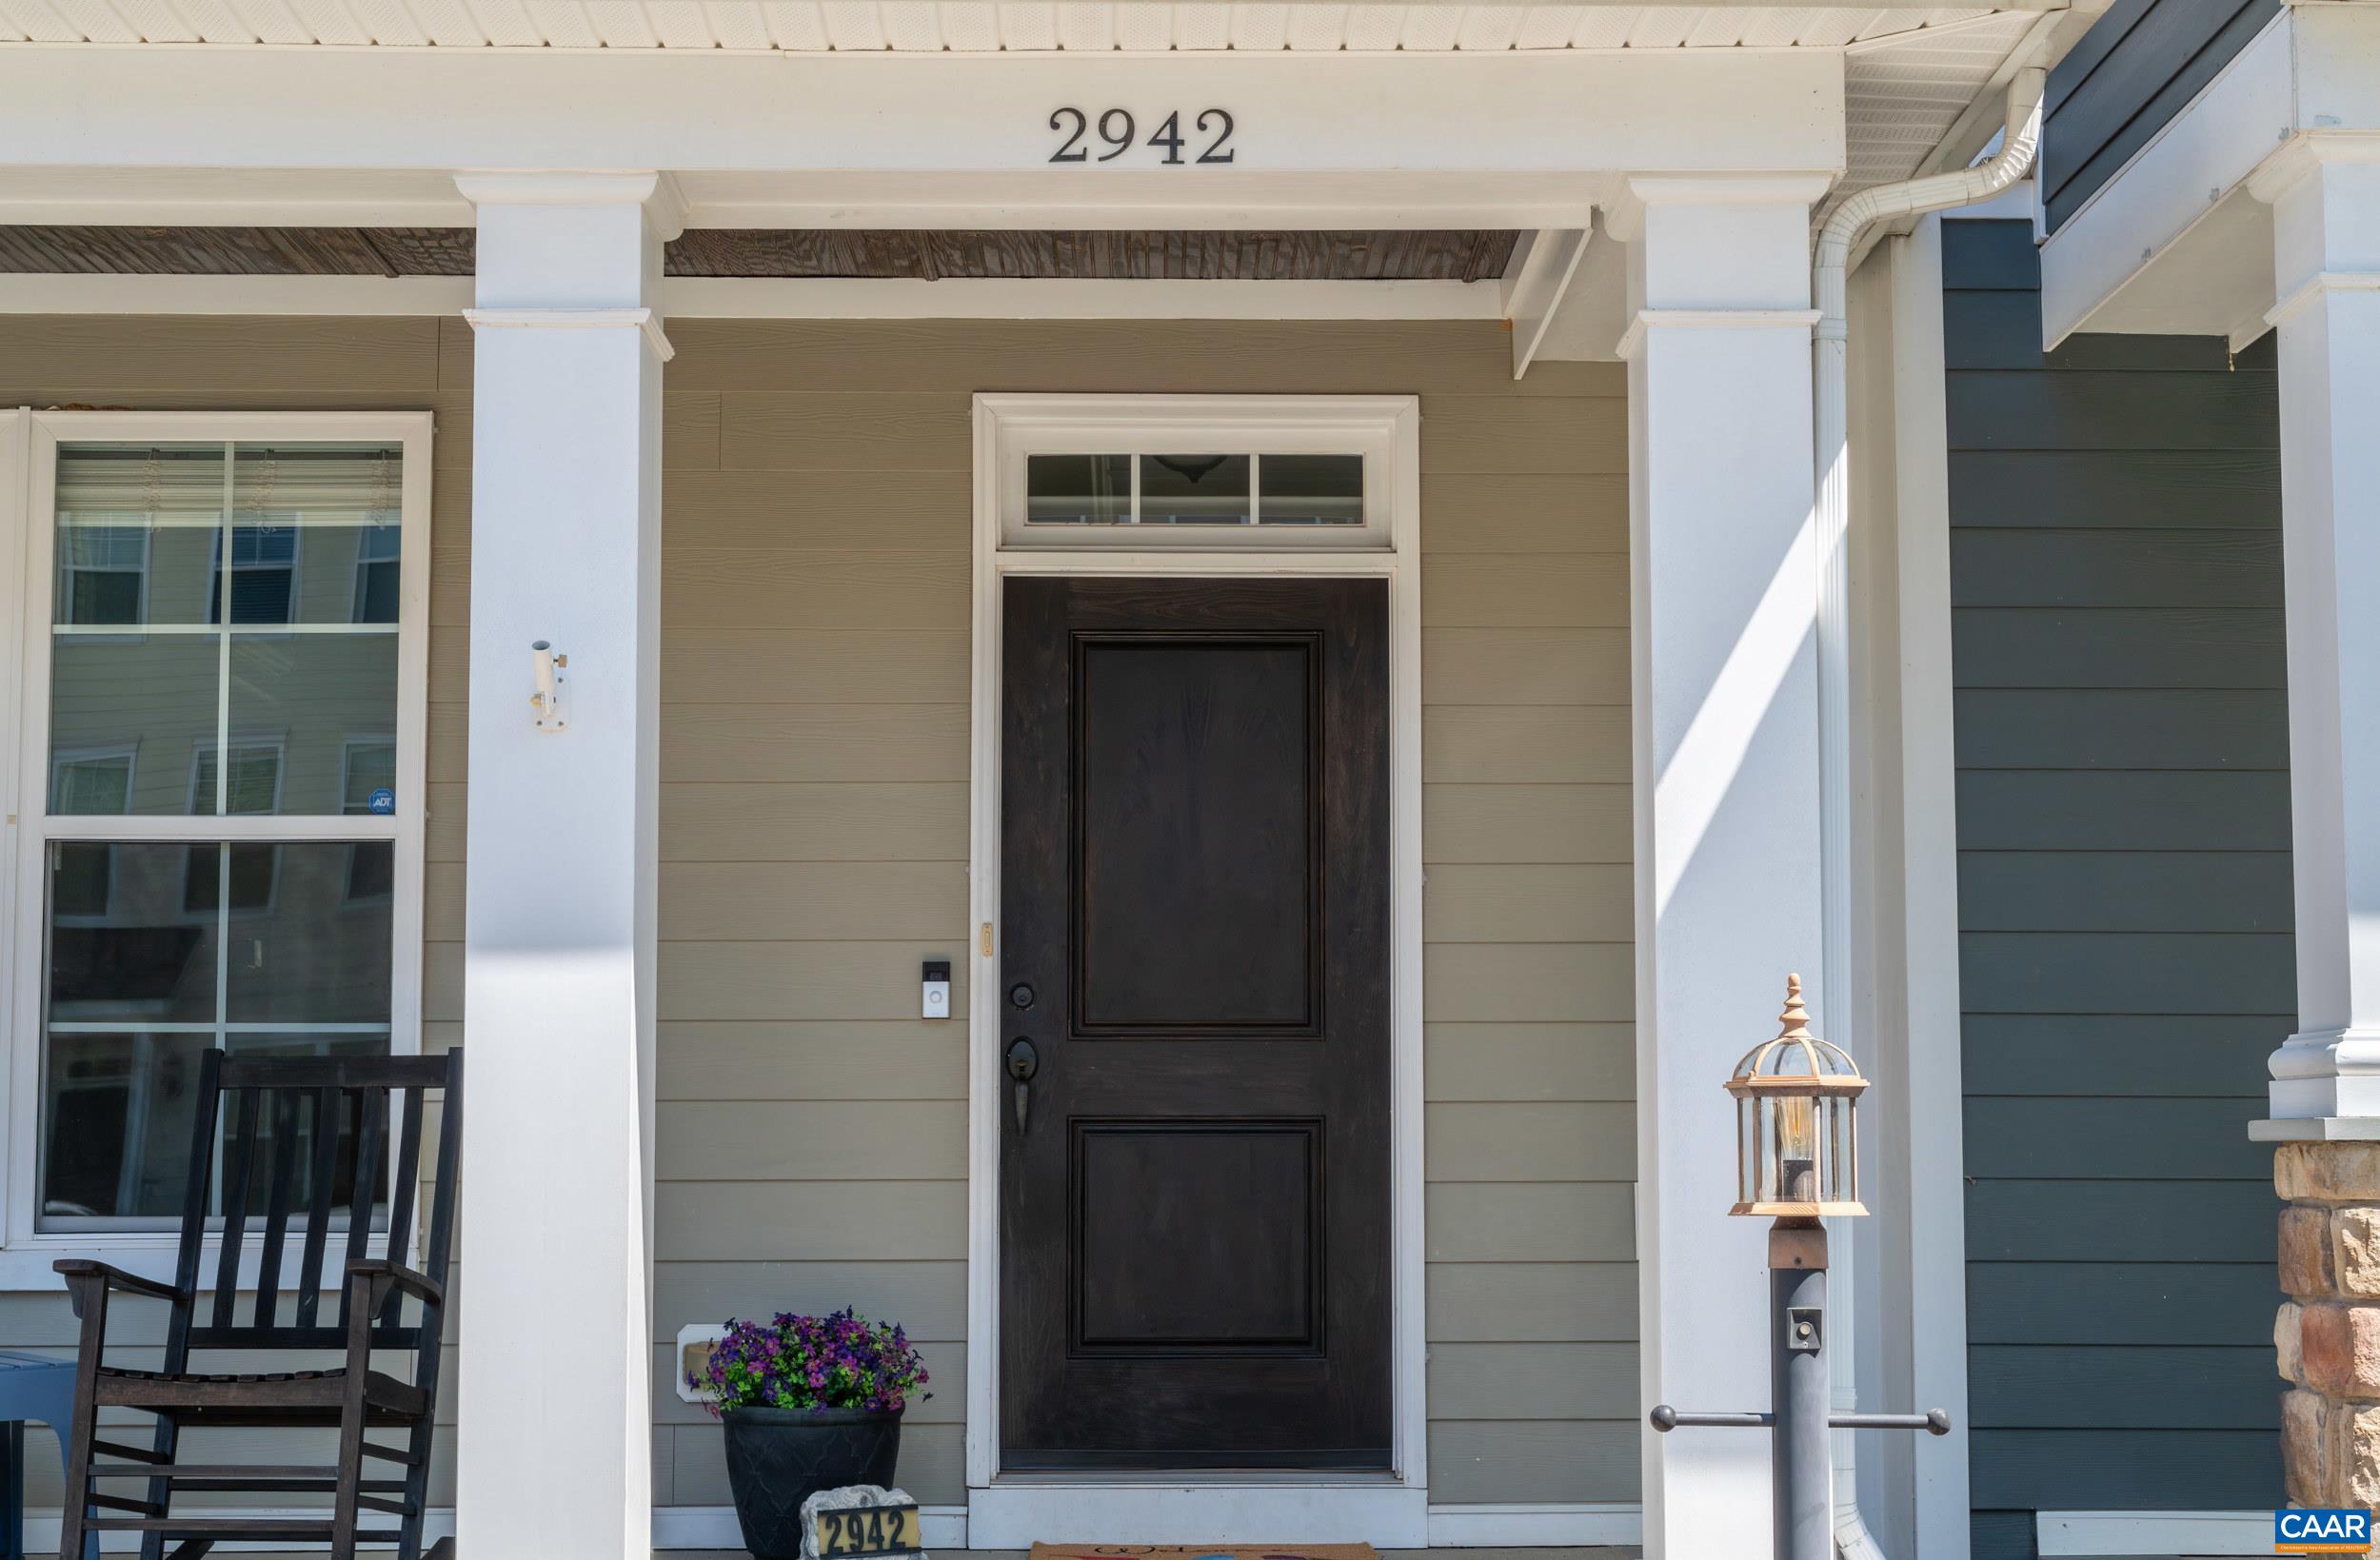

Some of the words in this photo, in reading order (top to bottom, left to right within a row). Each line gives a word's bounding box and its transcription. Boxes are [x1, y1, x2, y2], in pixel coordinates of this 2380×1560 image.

[1048, 107, 1235, 165] 2942
[373, 797, 392, 807] ADT
[824, 1510, 907, 1554] 2942
